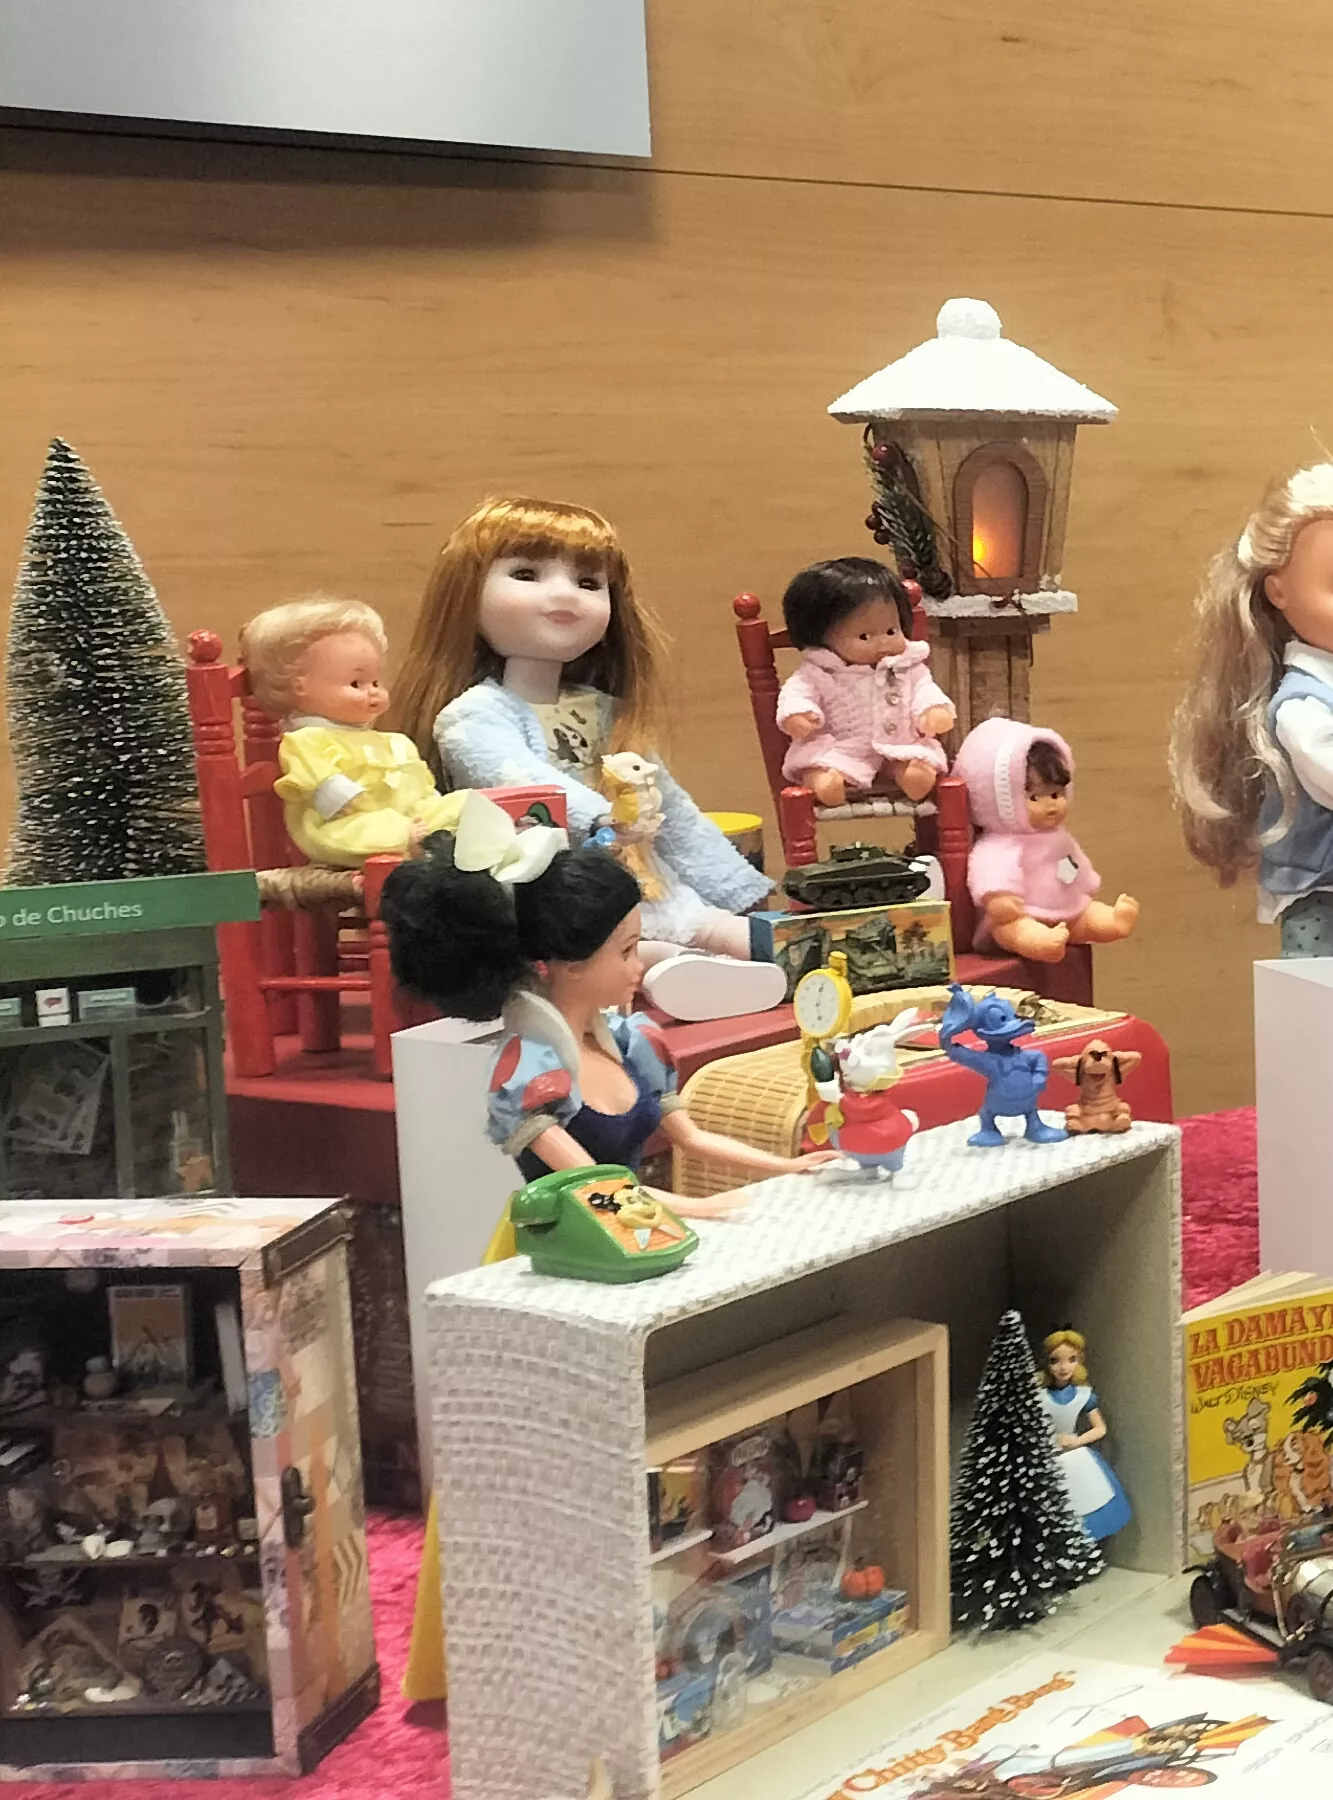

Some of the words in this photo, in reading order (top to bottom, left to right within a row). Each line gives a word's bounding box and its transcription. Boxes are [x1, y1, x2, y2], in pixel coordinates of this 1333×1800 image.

[12, 908, 42, 925] de
[47, 902, 143, 923] Chuches
[1189, 1328, 1220, 1359] LA
[1224, 1305, 1309, 1350] DAMA
